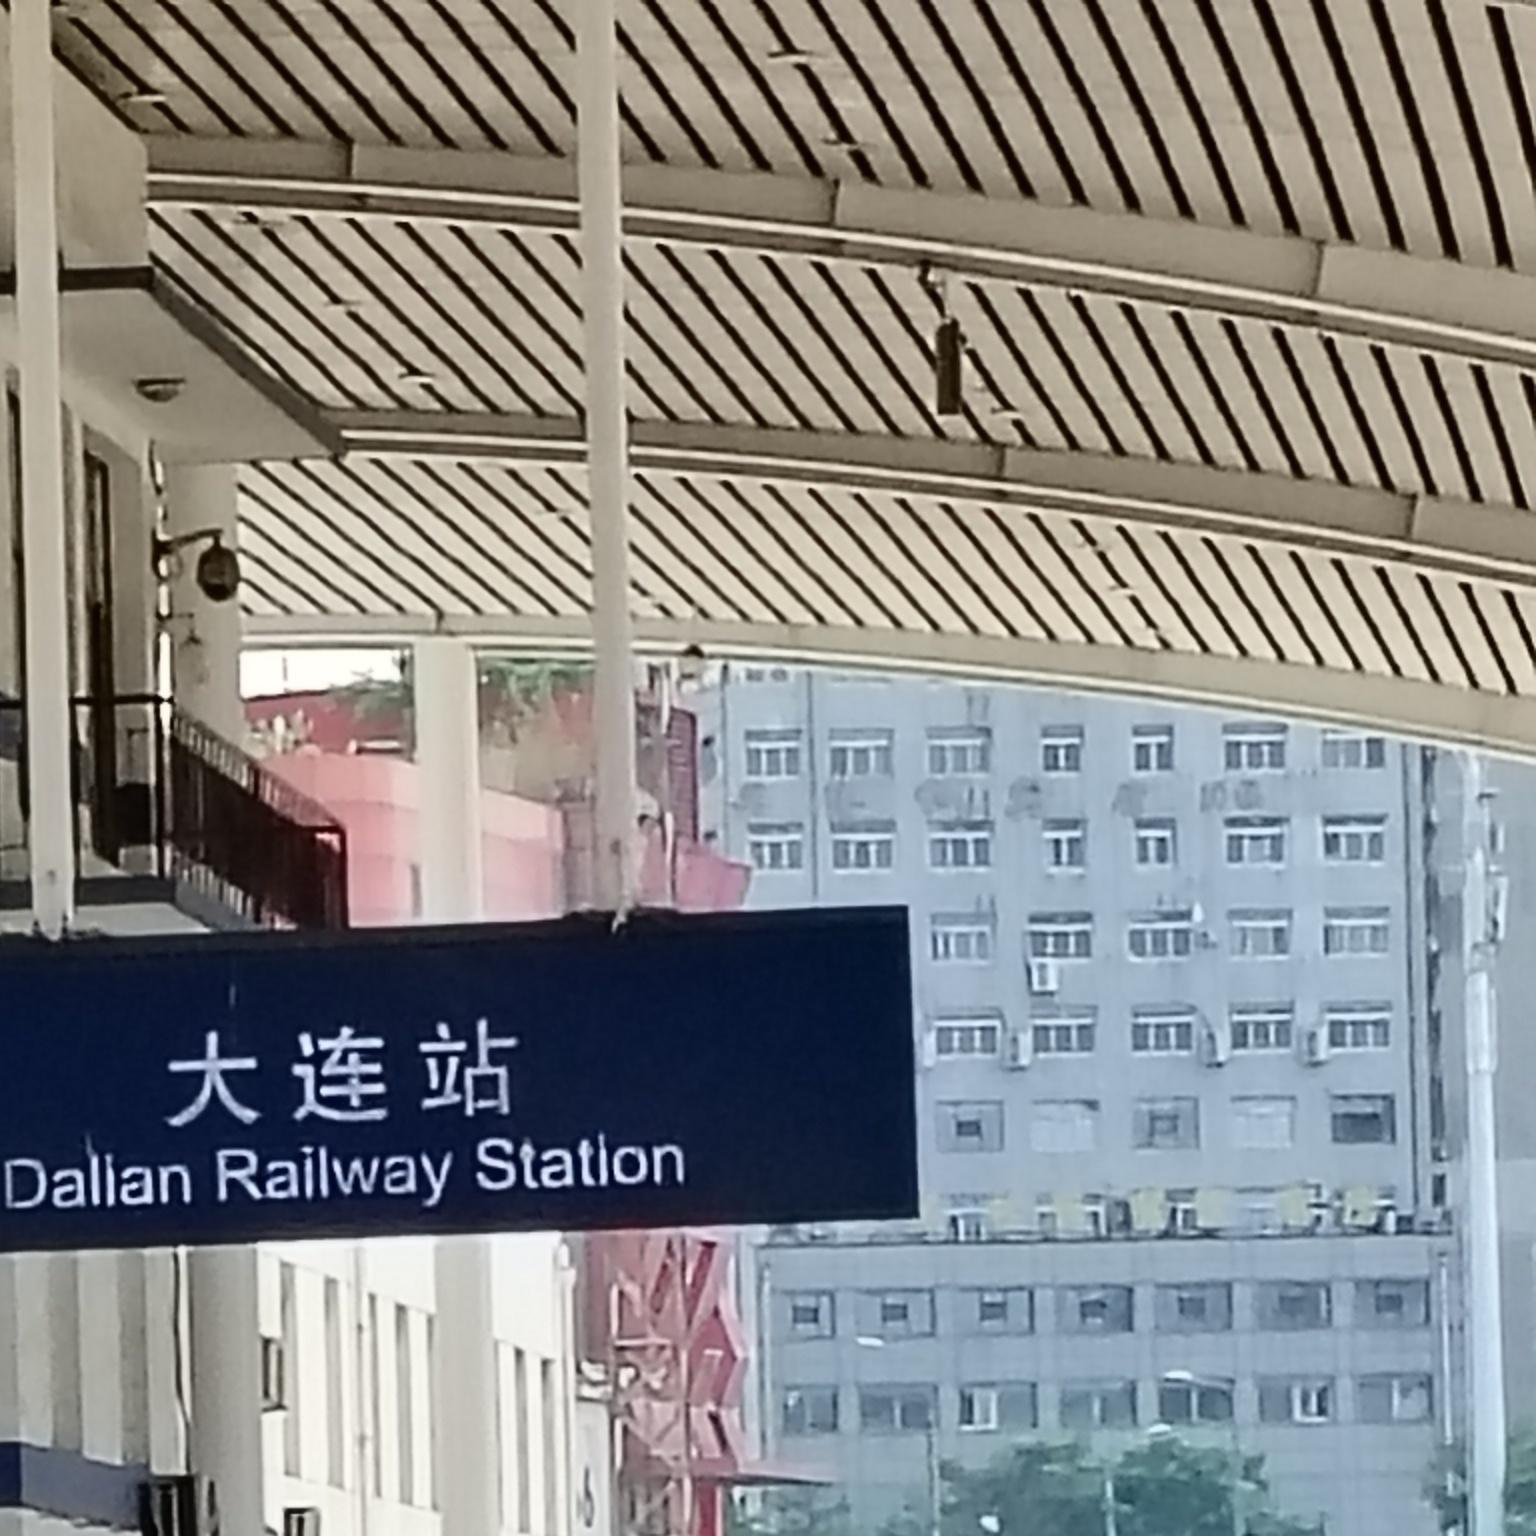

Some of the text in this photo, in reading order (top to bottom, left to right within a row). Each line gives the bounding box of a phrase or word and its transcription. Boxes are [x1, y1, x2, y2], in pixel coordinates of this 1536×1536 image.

[167, 1018, 518, 1126] 大连站
[4, 1132, 686, 1210] Dalian Railway Station
